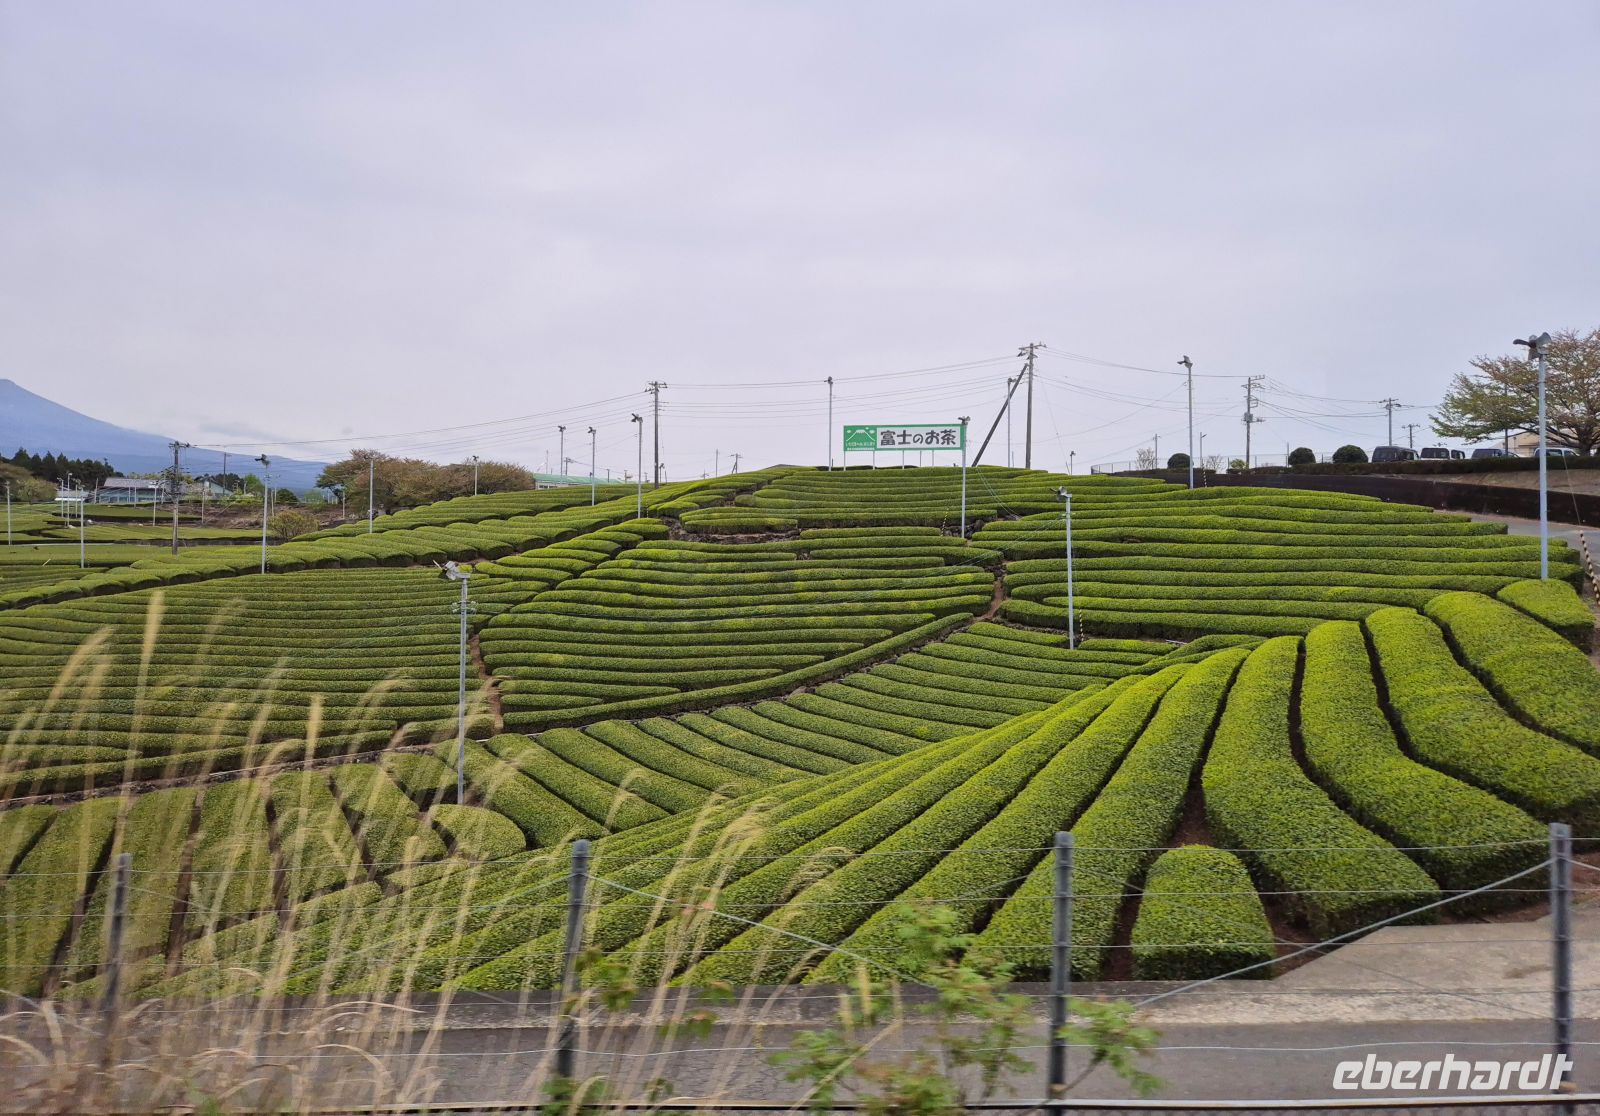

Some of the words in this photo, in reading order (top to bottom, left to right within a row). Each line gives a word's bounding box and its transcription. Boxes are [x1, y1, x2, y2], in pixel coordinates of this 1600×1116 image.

[880, 429, 957, 446] 富士のお茶
